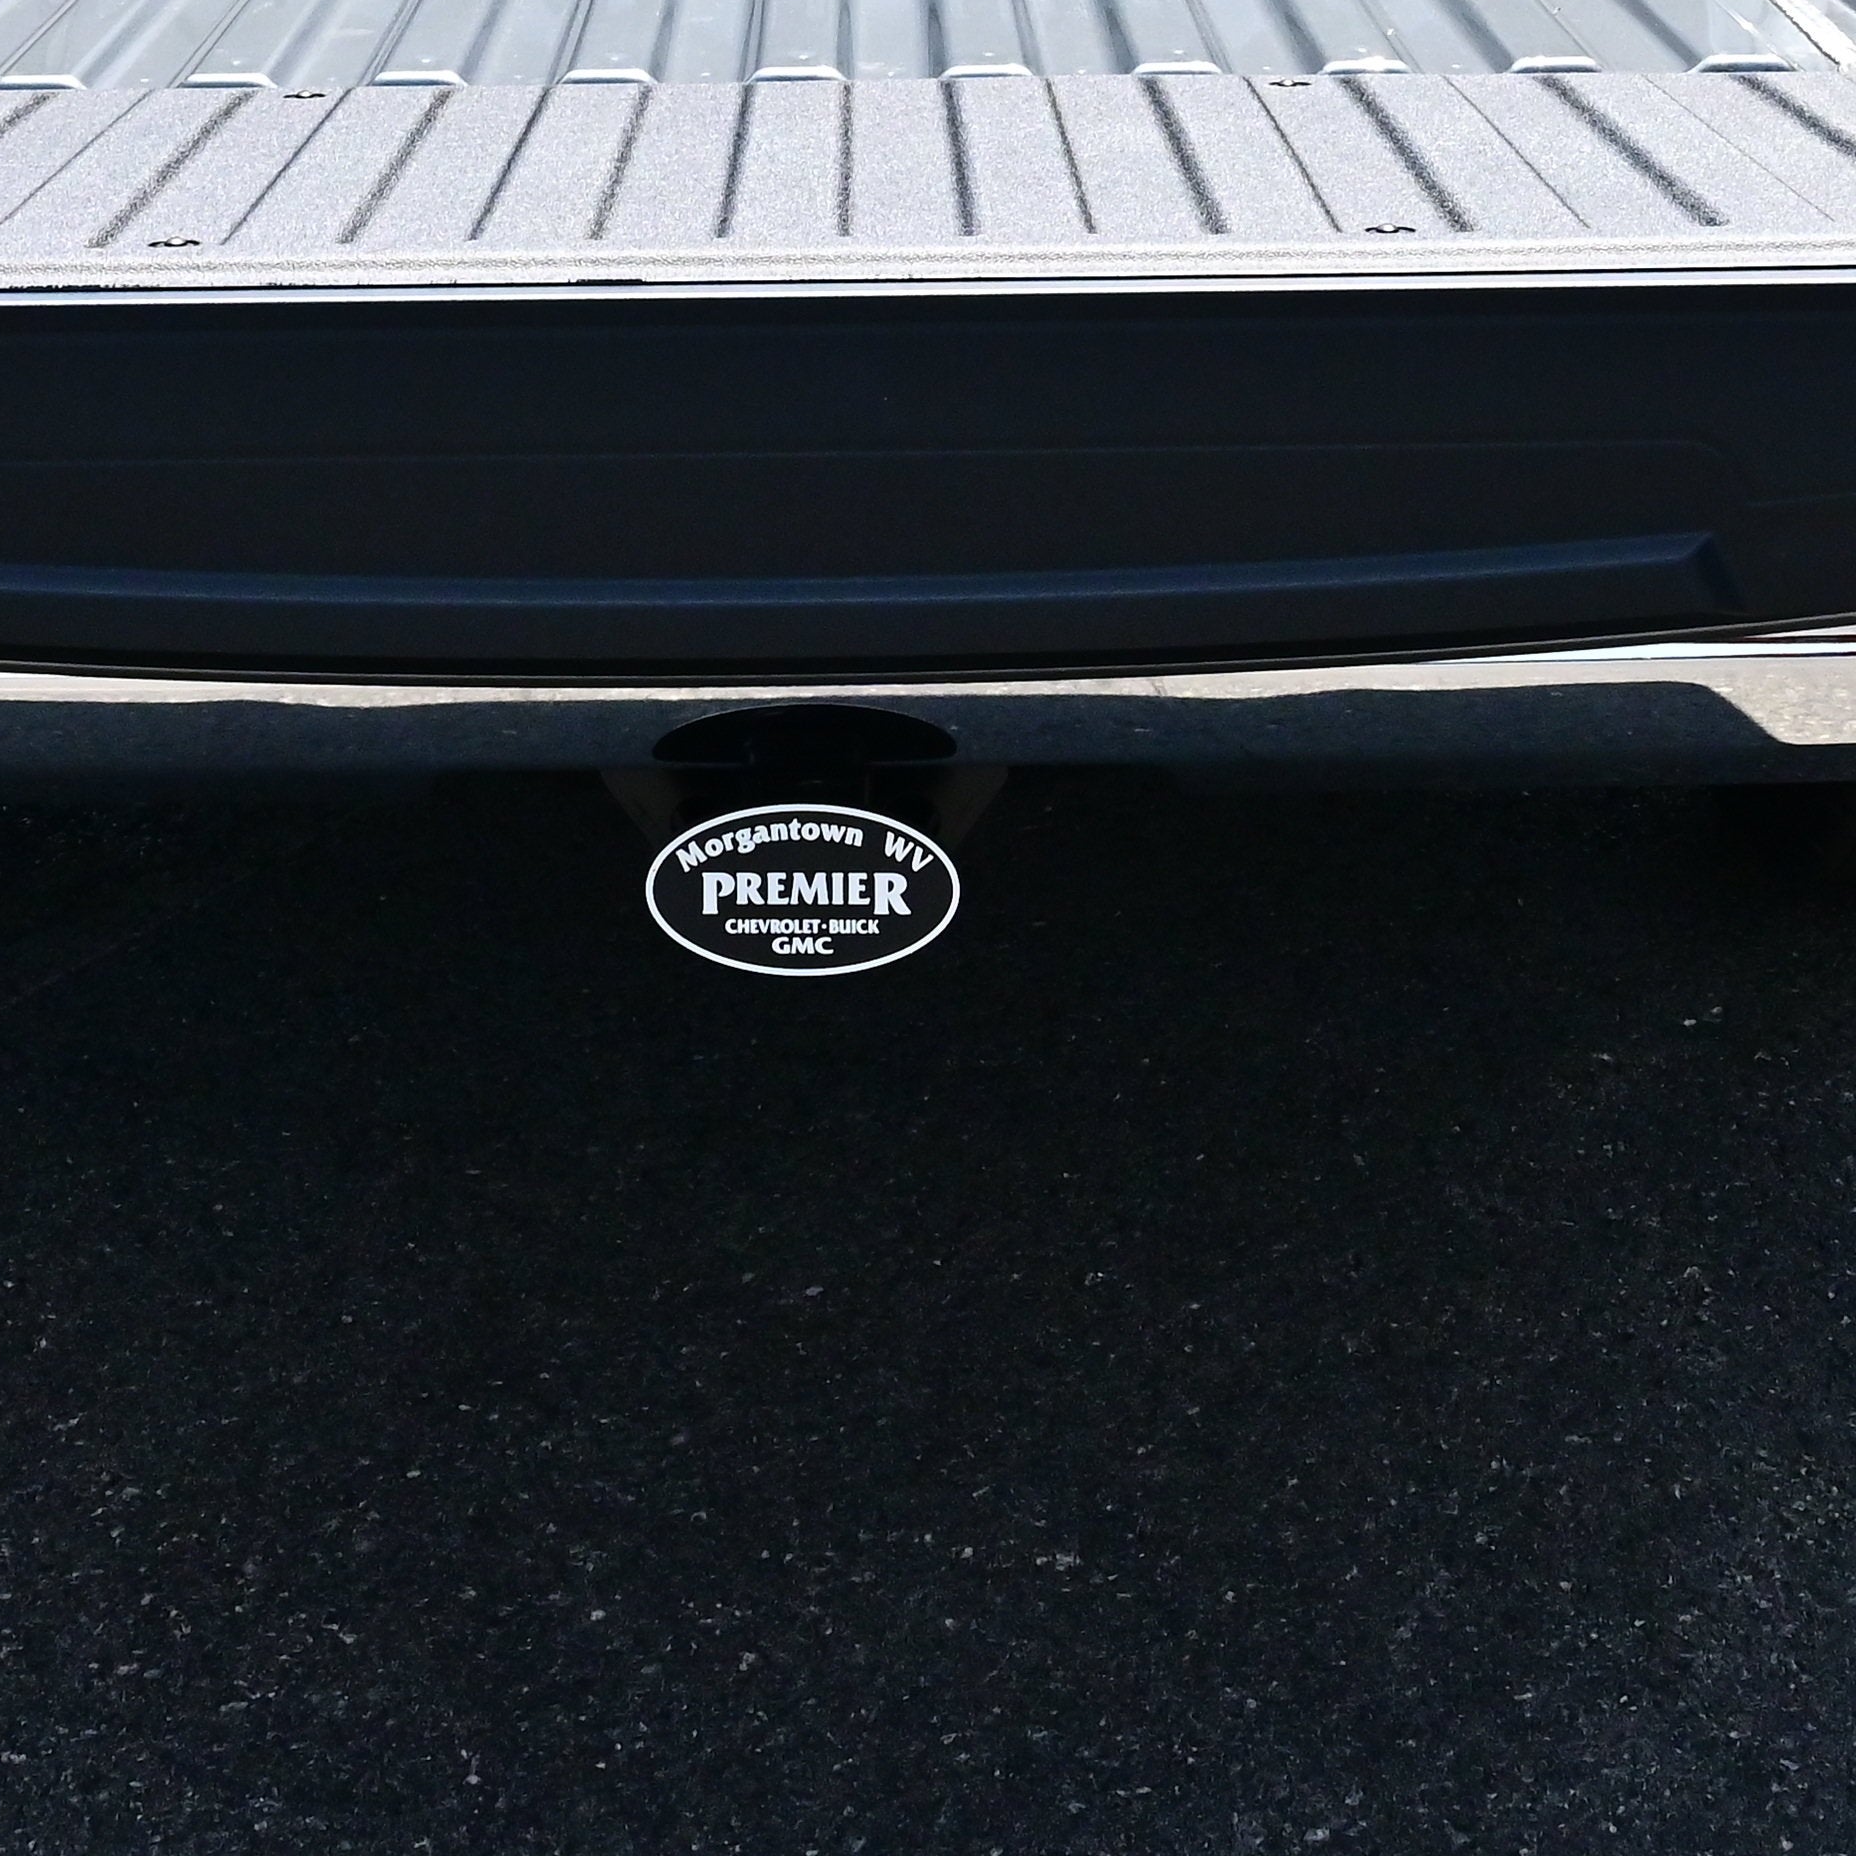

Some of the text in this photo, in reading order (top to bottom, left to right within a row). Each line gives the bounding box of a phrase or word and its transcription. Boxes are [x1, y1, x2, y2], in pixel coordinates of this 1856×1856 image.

[675, 818, 935, 873] Morgantown WV
[701, 871, 912, 916] PREMIER
[771, 936, 835, 955] GMC
